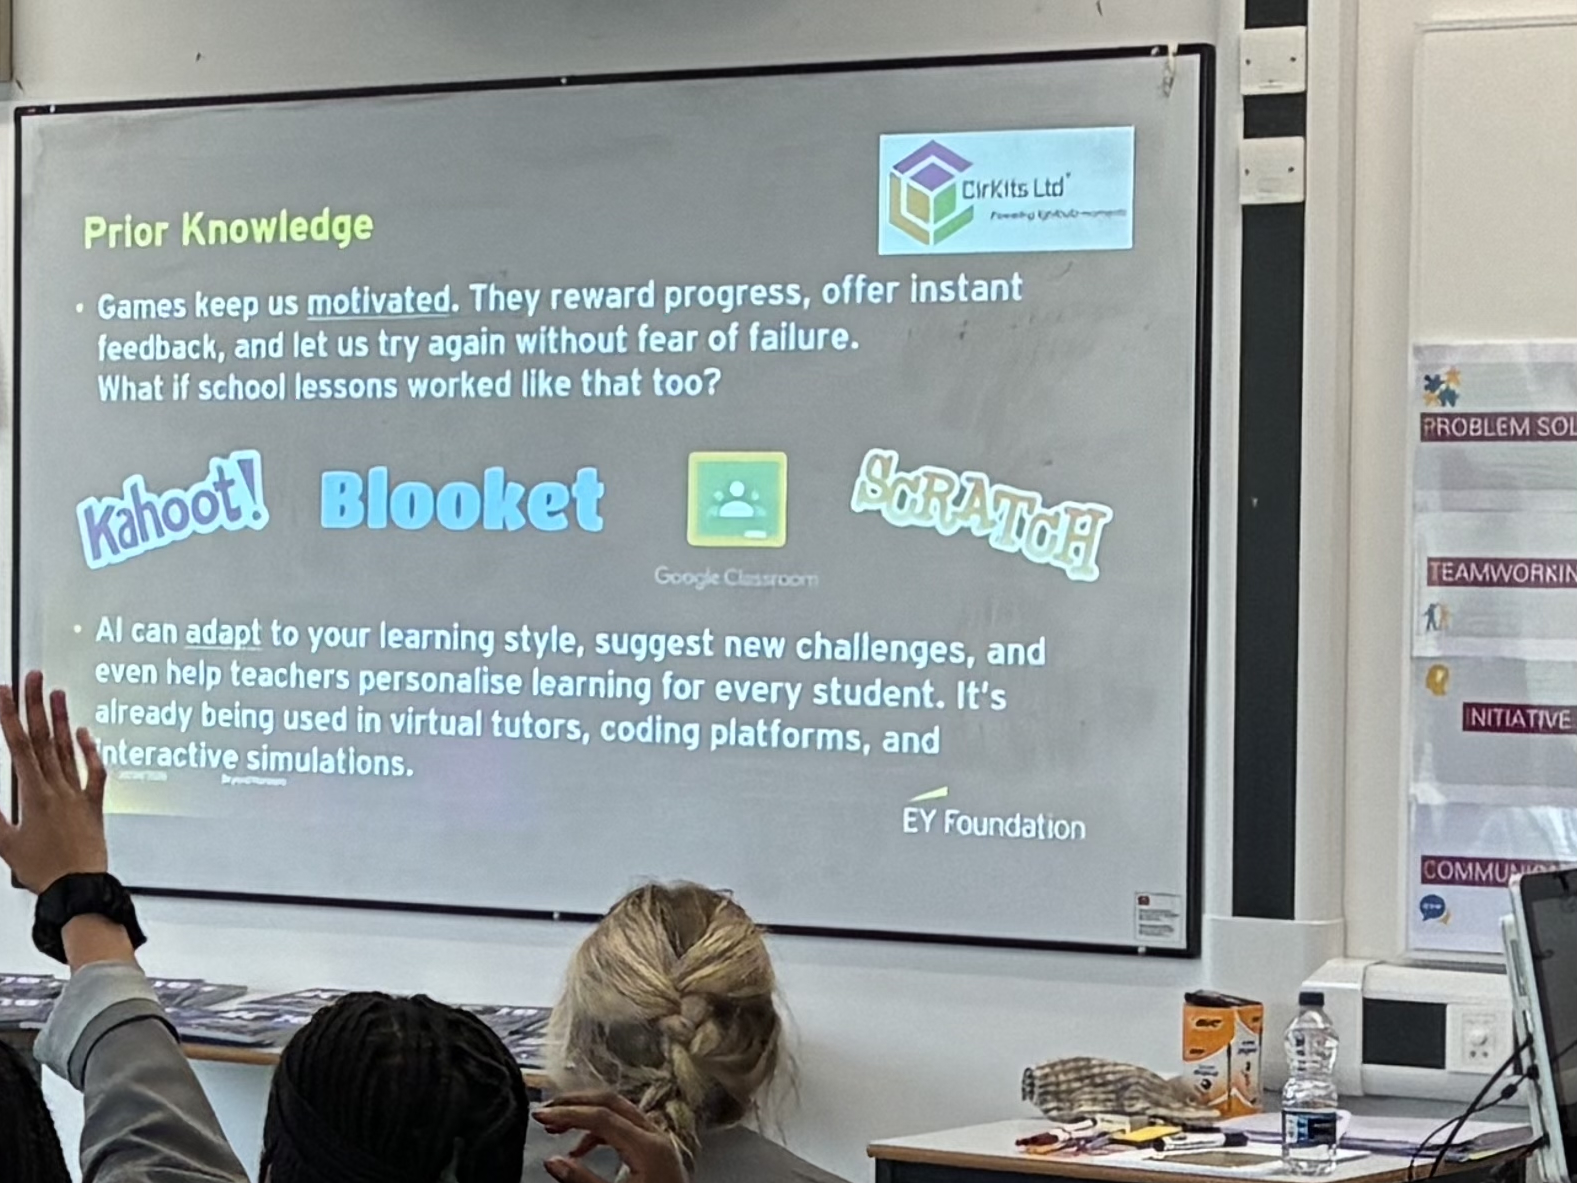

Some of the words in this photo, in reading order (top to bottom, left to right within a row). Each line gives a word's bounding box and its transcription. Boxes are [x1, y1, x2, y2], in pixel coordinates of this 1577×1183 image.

[962, 177, 1029, 199] CirKits
[84, 214, 169, 248] Prior
[181, 207, 374, 248] Knowledge
[98, 293, 187, 320] Games
[194, 291, 259, 322] keep
[268, 293, 299, 317] us
[307, 284, 460, 319] motivated.
[469, 283, 541, 316] They
[551, 279, 655, 309] reward
[664, 281, 811, 313] progress,
[822, 273, 900, 305] offer
[910, 272, 1023, 302] instant
[98, 333, 225, 364] feedback,
[234, 331, 284, 359] and
[293, 331, 329, 359] let
[337, 333, 368, 357] us
[378, 328, 419, 362] try
[428, 326, 506, 362] again
[516, 323, 628, 357] without
[637, 324, 699, 352] fear
[708, 321, 739, 352] of
[749, 321, 859, 352] failure.
[98, 374, 164, 401] What
[173, 373, 190, 400] if
[198, 372, 286, 401] school
[295, 372, 398, 400] lessons
[408, 369, 511, 399] worked
[522, 368, 571, 398] like
[581, 367, 642, 397] that
[652, 366, 721, 397] too?
[1424, 417, 1530, 437] PROBLEM
[80, 455, 265, 564] Kahoot!
[321, 466, 605, 532] Blooket
[654, 566, 721, 590] Google
[724, 568, 819, 588] Classroom
[95, 616, 123, 644] AI
[131, 621, 178, 645] can
[185, 617, 263, 651] adapt
[271, 619, 299, 647] to
[308, 625, 370, 654] your
[379, 619, 495, 657] learning
[503, 625, 585, 660] style,
[595, 627, 714, 662] suggest
[724, 634, 785, 660] new
[796, 631, 976, 669] challenges,
[986, 636, 1046, 667] and
[95, 661, 158, 686] even
[166, 658, 221, 691] help
[230, 659, 350, 690] teachers
[359, 665, 523, 697] personalise
[531, 667, 651, 705] learning
[662, 671, 705, 702] for
[715, 679, 802, 711] every
[813, 677, 945, 710] student.
[956, 679, 1007, 711] It's
[95, 699, 193, 733] already
[201, 700, 276, 735] being
[283, 705, 347, 734] used
[356, 704, 381, 734] in
[390, 706, 482, 738] virtual
[491, 709, 590, 745] tutors,
[600, 716, 700, 752] coding
[710, 716, 871, 755] platforms,
[882, 724, 940, 755] and
[1465, 707, 1572, 730] INITIATIVE
[96, 737, 239, 770] interactive
[247, 743, 414, 778] simulations.
[903, 807, 937, 834] EY
[944, 808, 1087, 841] Foundation
